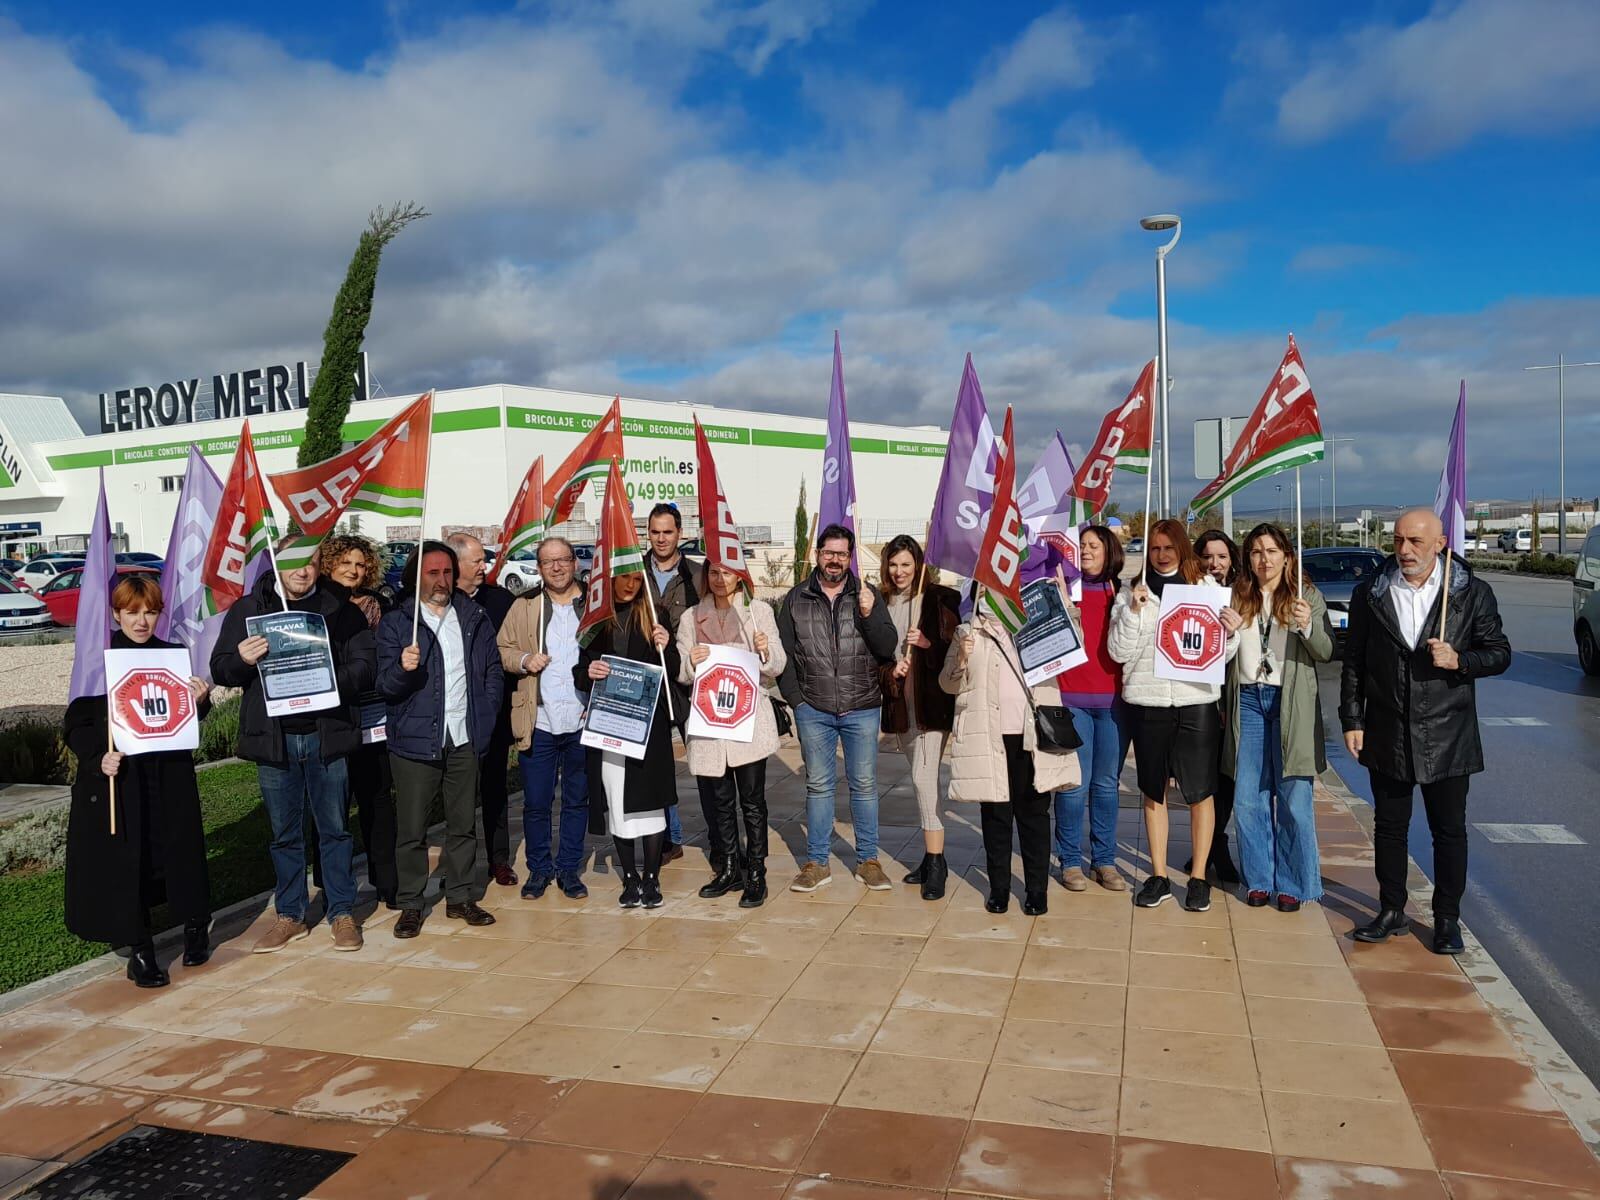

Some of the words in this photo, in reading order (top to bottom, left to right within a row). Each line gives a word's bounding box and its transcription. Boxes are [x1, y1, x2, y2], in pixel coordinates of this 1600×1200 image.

[99, 378, 203, 433] LEROY
[525, 413, 574, 427] BRICOLAJE
[704, 428, 739, 440] ARDINERÍA
[638, 482, 655, 500] 49
[658, 482, 675, 500] 99
[265, 622, 305, 633] ESCLAVAS
[1182, 632, 1202, 649] NO
[610, 670, 643, 682] ESCLAVAS
[144, 698, 167, 716] NO
[717, 691, 735, 708] NO
